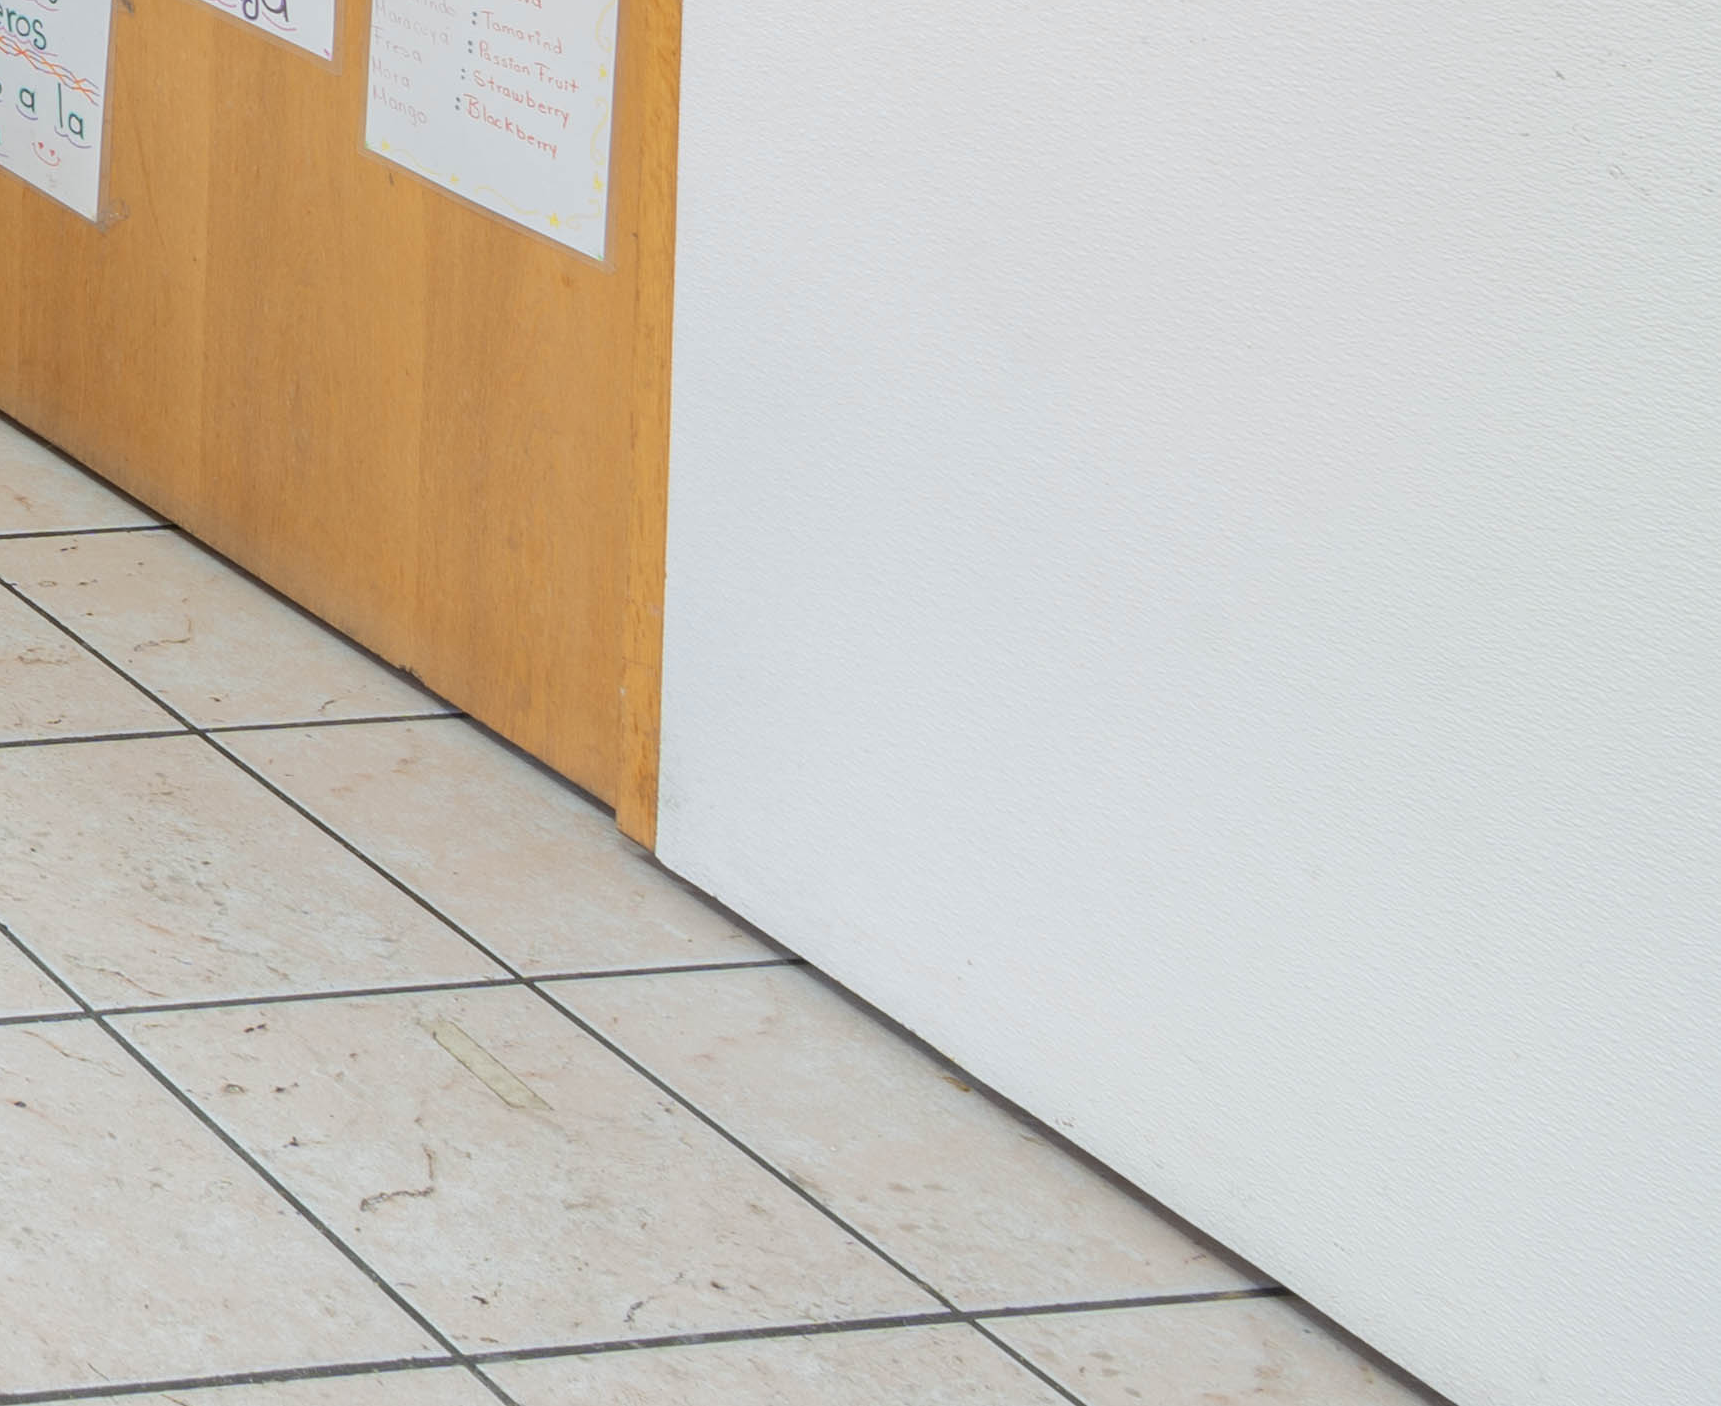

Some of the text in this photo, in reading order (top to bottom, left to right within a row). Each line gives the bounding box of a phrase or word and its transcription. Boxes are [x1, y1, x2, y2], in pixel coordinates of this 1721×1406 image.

[473, 69, 570, 130] Strawberry
[534, 62, 580, 93] Fruit
[19, 88, 36, 114] a
[57, 82, 86, 138] la
[373, 85, 427, 126] Mango
